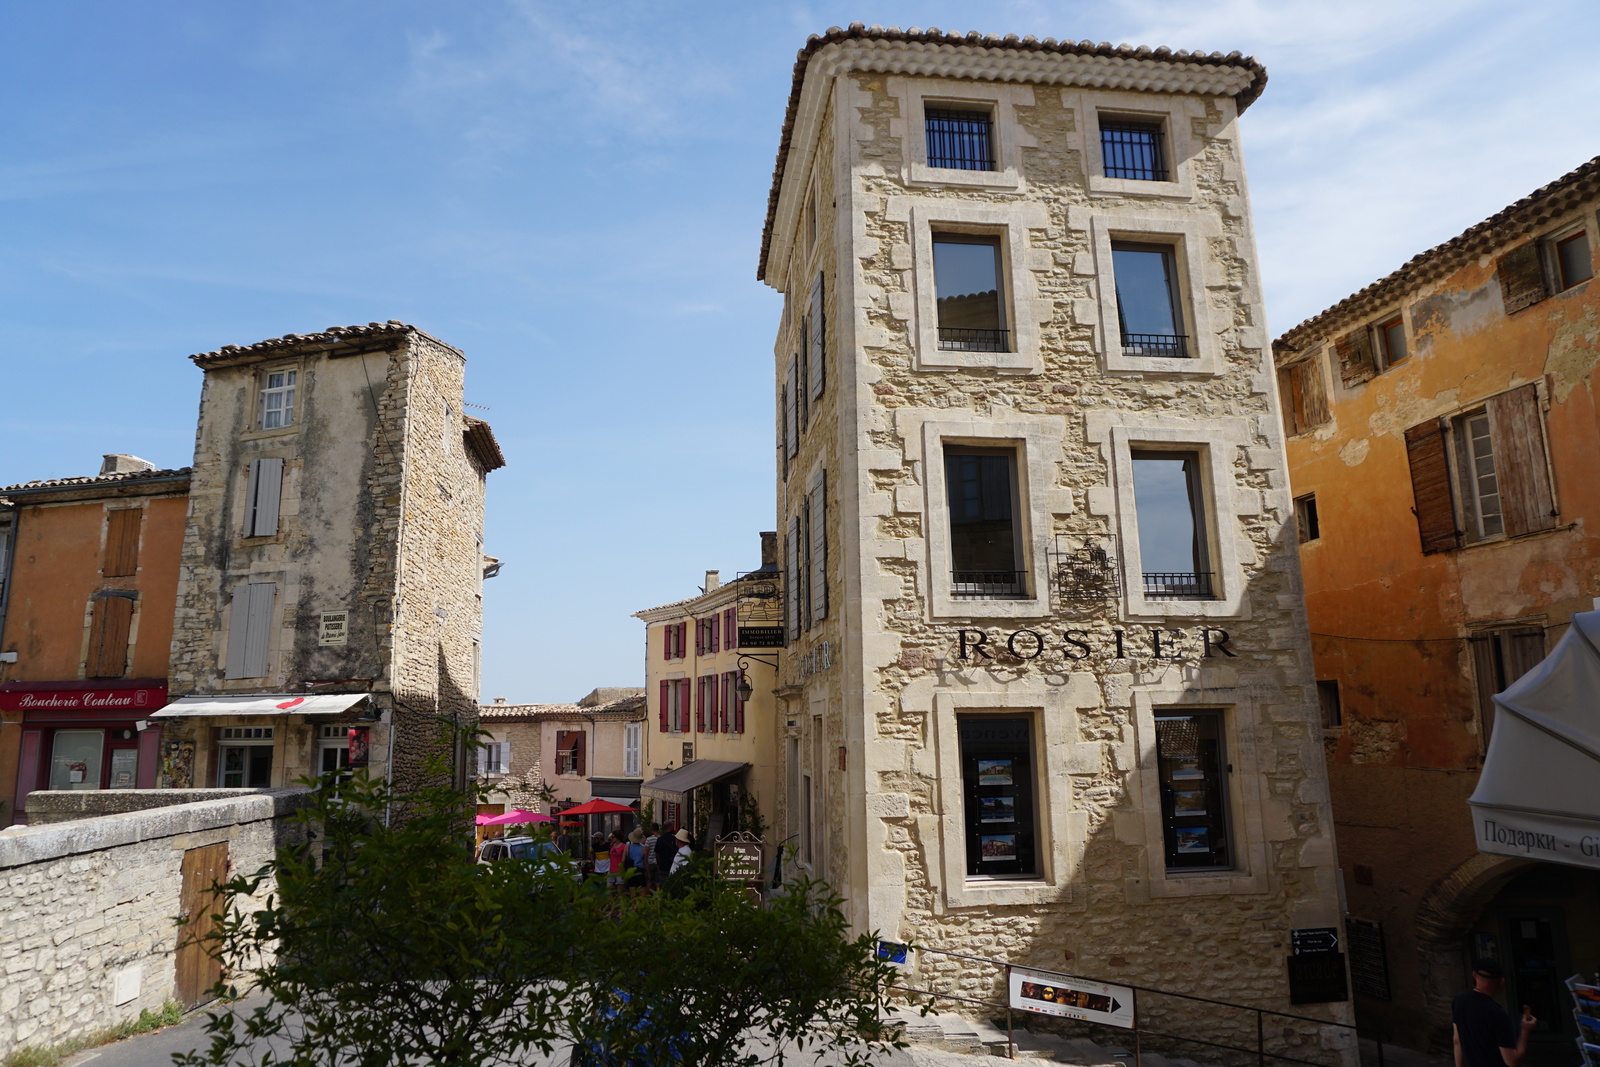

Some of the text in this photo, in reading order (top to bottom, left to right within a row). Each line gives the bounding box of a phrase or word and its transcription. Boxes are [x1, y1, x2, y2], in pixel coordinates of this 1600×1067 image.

[323, 614, 346, 622] BOULANGERIE
[325, 622, 343, 630] PATISSERIE
[957, 628, 1238, 660] ROSIER
[19, 693, 79, 708] Boucherie
[1484, 820, 1557, 853] Подарки
[1295, 956, 1339, 981] arcade
